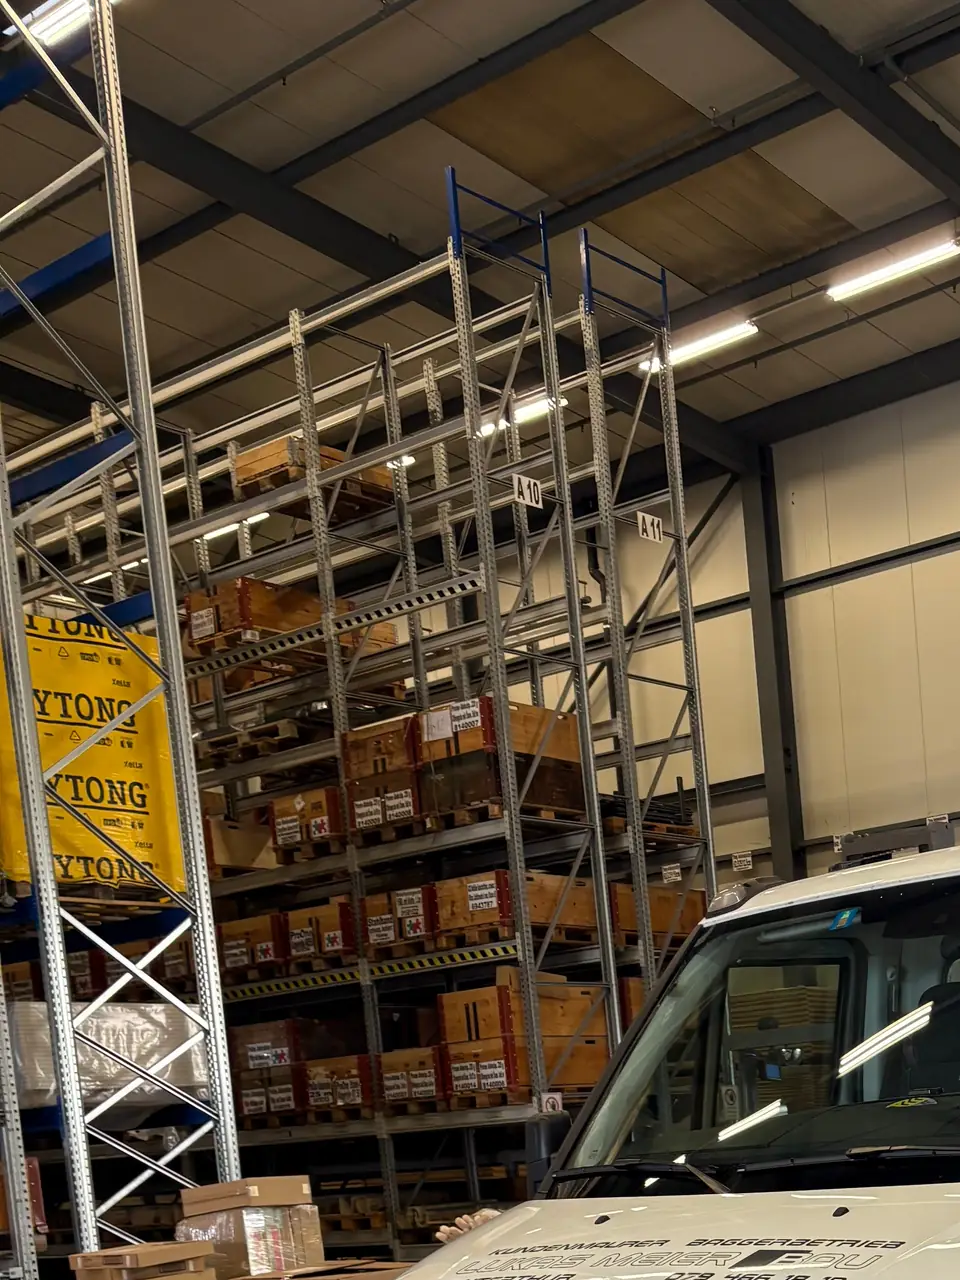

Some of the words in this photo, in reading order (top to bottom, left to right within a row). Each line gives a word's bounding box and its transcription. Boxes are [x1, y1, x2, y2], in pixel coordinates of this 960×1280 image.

[517, 477, 525, 500] A
[527, 481, 540, 505] 10
[641, 516, 649, 537] A
[651, 519, 662, 541] 11
[488, 1239, 671, 1256] KUNDENMAURER
[685, 1238, 906, 1250] BAGGERBETRIEB
[455, 1253, 595, 1274] LUKAS
[589, 1251, 742, 1268] MEIER
[764, 1250, 883, 1270] BAU
